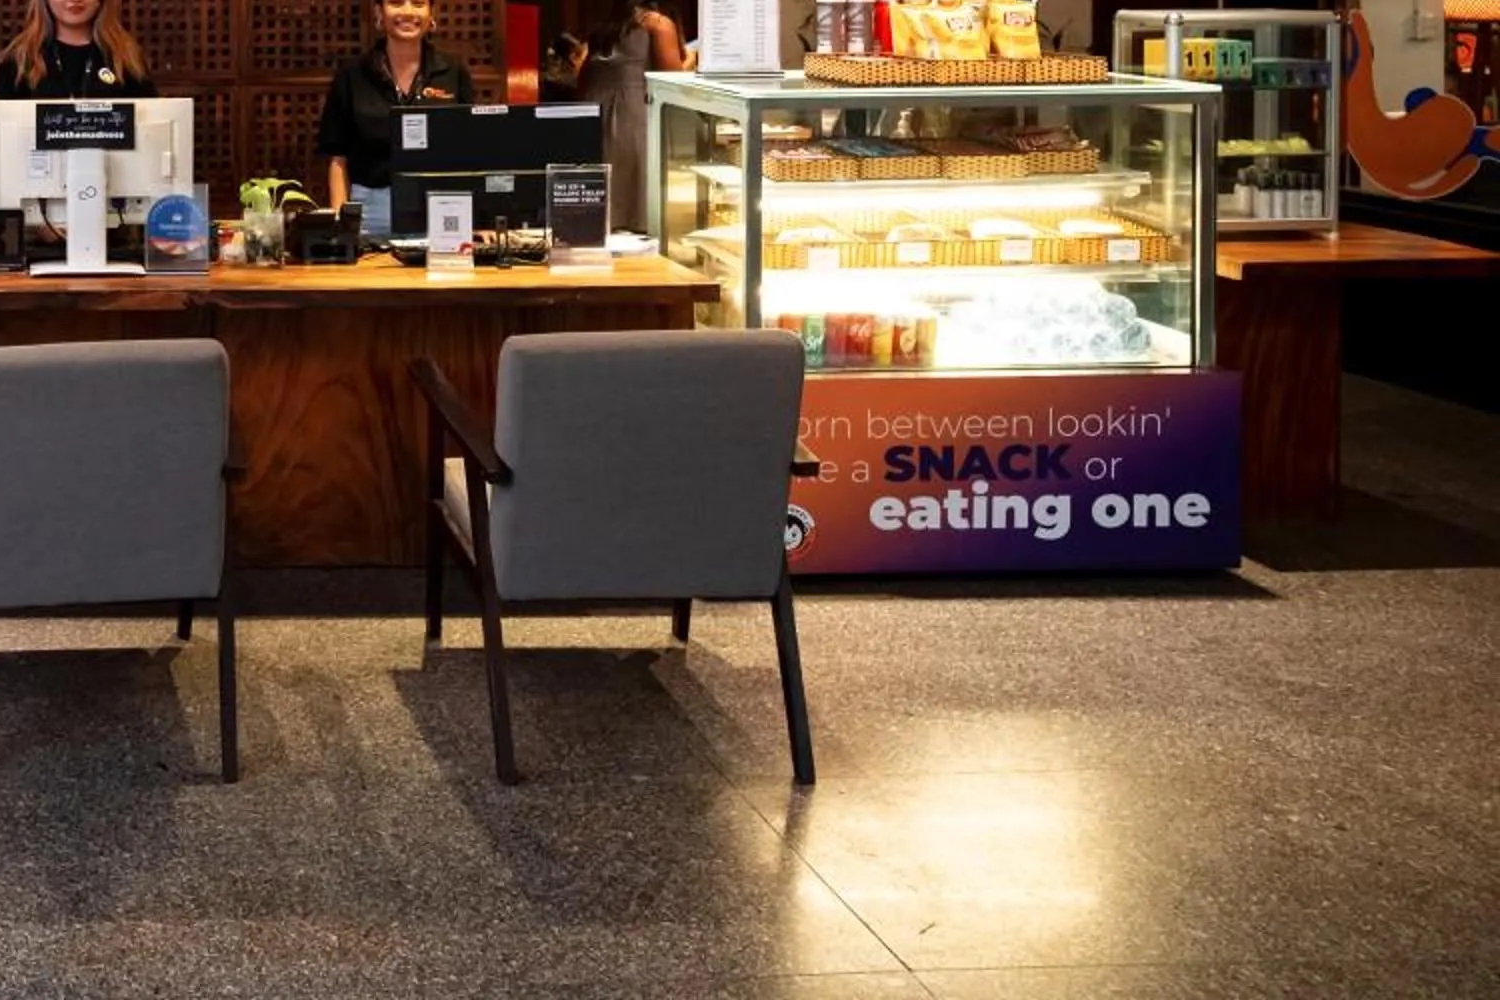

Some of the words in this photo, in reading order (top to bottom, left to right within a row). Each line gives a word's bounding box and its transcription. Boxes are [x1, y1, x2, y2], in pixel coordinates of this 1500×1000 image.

[799, 416, 851, 440] orn
[867, 407, 1034, 440] between
[1048, 406, 1172, 438] lookin'
[851, 460, 870, 483] a
[883, 444, 1072, 483] SNACK
[1084, 456, 1123, 482] or
[868, 480, 1072, 542] eating
[1090, 491, 1212, 529] one
